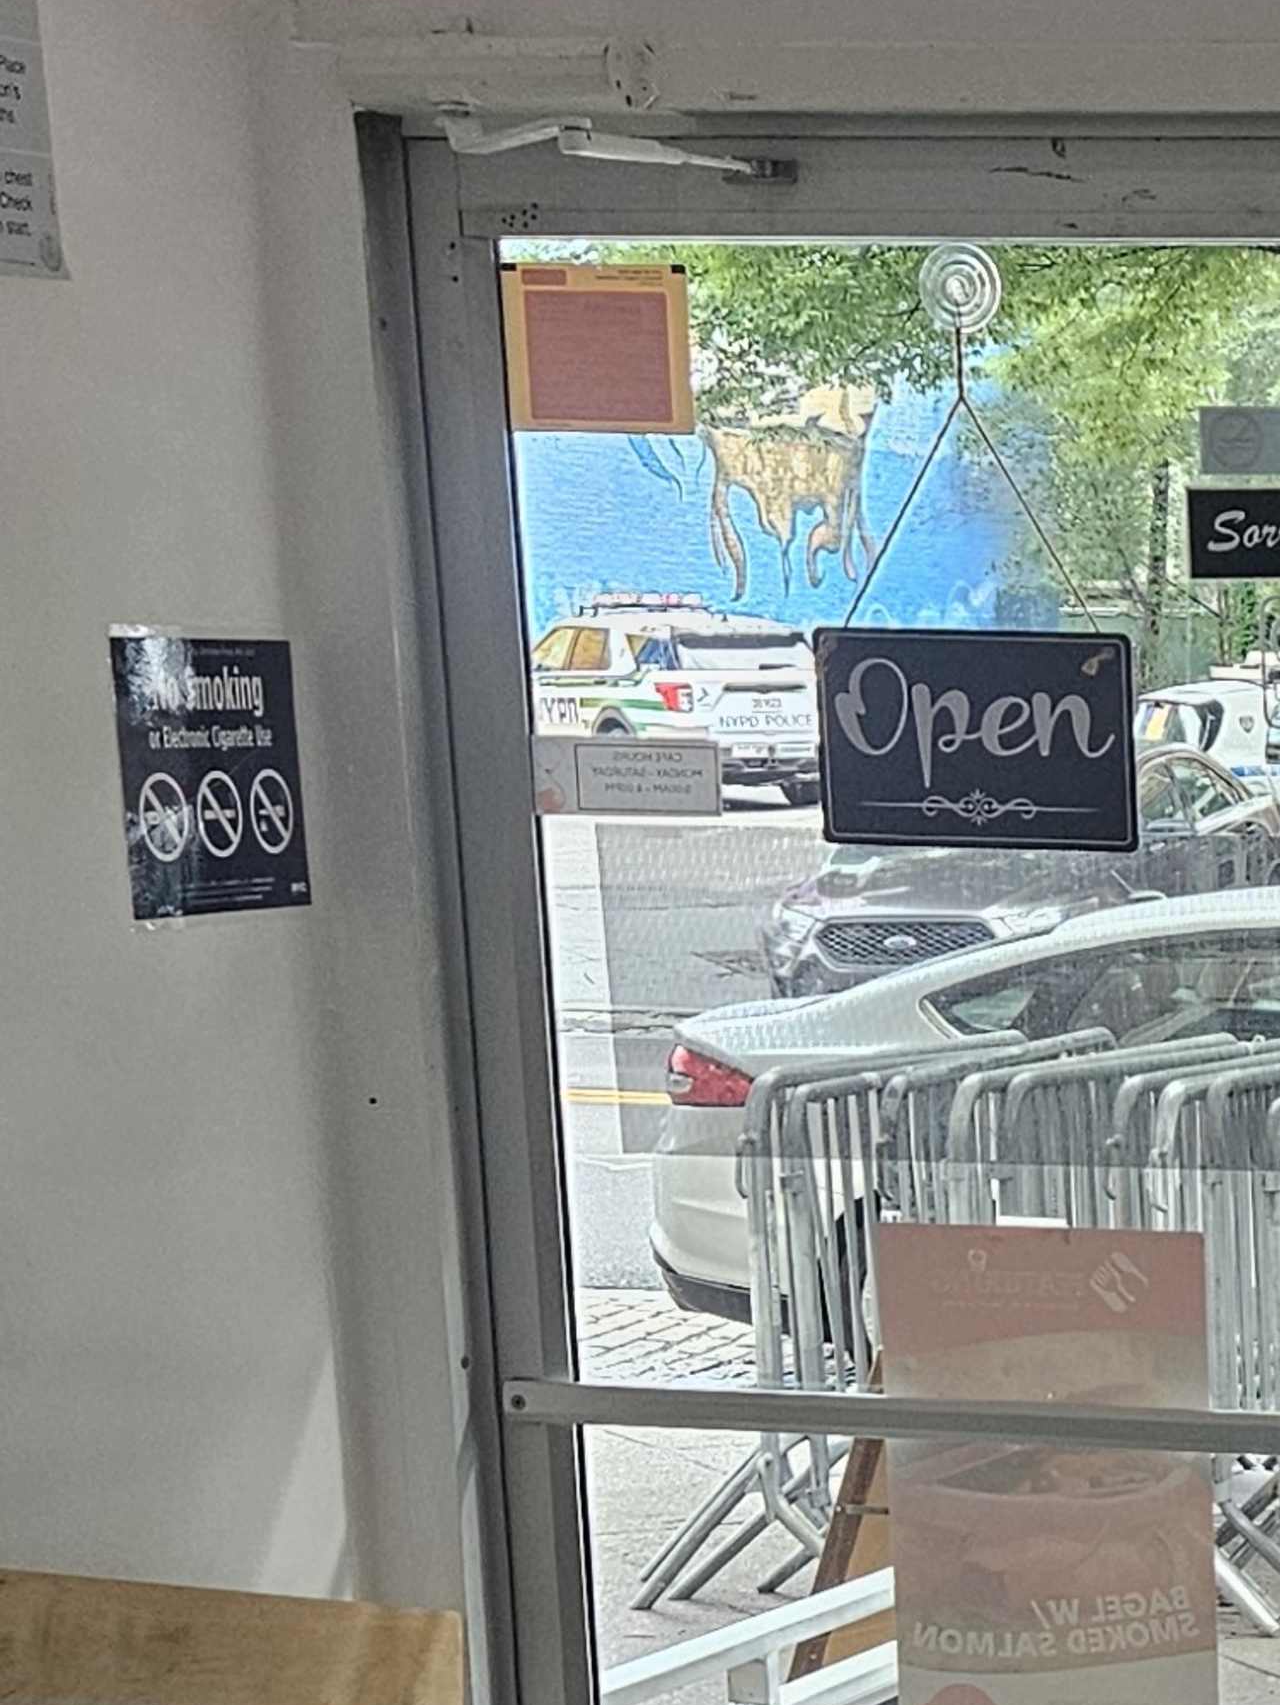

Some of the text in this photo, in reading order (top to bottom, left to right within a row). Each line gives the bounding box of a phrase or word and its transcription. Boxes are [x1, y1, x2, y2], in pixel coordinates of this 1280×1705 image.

[183, 664, 264, 718] Smoking
[718, 713, 813, 728] NYPD POLICE
[834, 658, 1119, 789] Open
